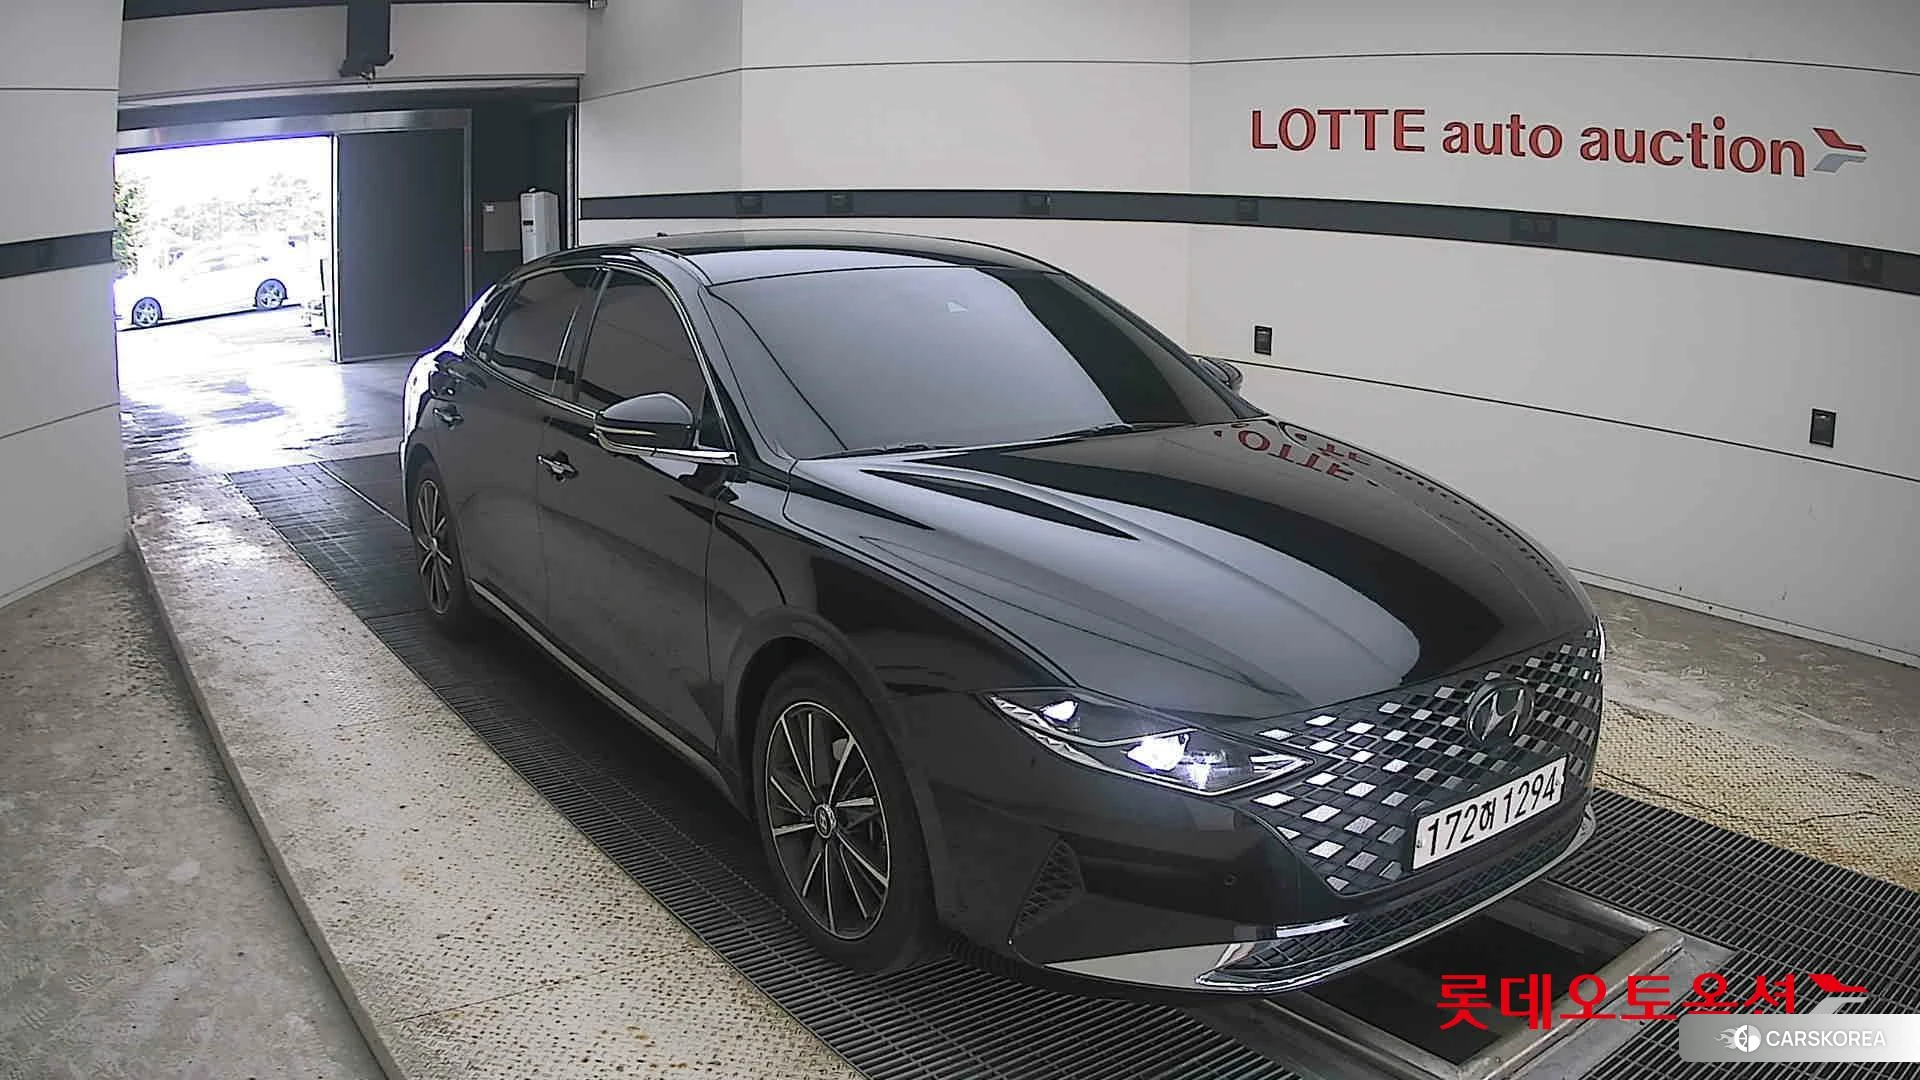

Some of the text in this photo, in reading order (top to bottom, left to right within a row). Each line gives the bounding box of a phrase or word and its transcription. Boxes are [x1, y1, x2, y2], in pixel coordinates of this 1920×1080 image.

[1251, 108, 1806, 177] LOTTE auto auction
[1427, 766, 1558, 857] 172허 1294
